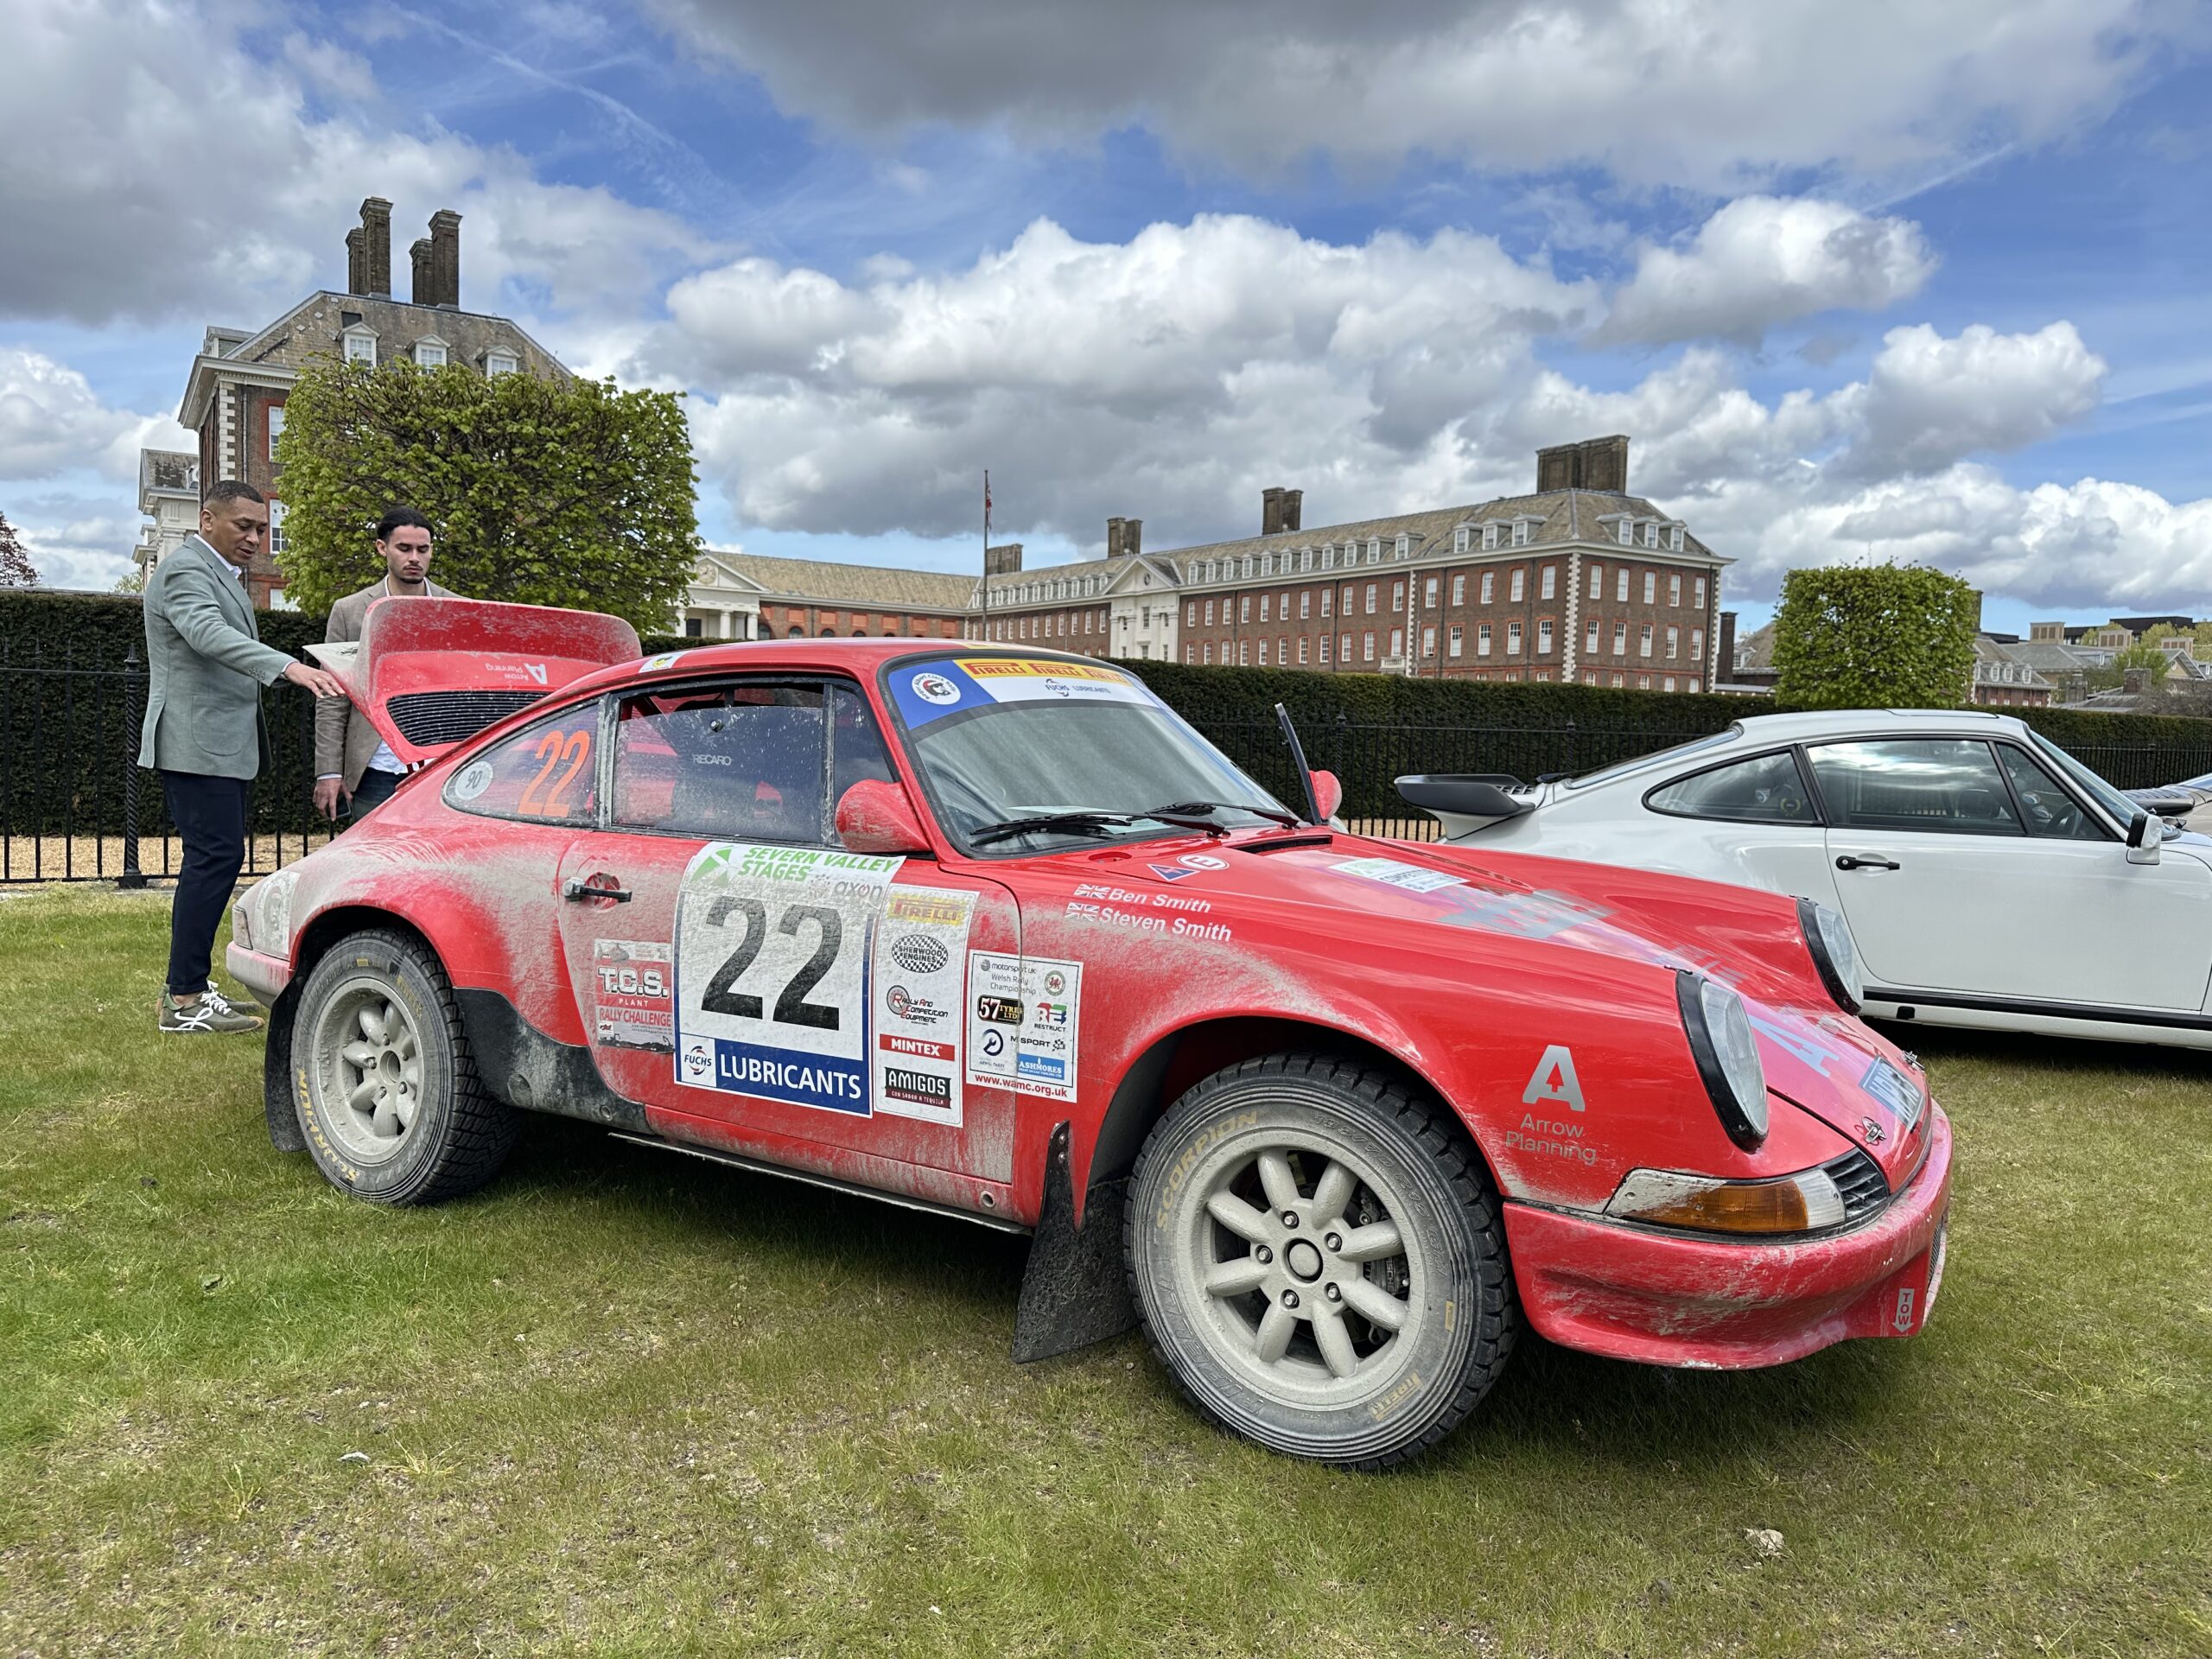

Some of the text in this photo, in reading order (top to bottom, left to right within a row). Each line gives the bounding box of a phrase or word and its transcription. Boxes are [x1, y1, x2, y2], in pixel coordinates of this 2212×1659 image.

[963, 663, 1027, 675] PIRELLI
[1027, 664, 1082, 677] PIRELLI
[693, 754, 732, 766] RECARO
[465, 770, 483, 789] 90
[518, 730, 590, 817] 22
[744, 847, 899, 873] SEVERN VALLEY
[738, 861, 814, 882] STAGES
[834, 880, 883, 901] axon
[1109, 888, 1211, 913] Ben Smith
[893, 898, 963, 921] PIRELLI
[1099, 907, 1232, 942] Steven Smith
[898, 946, 943, 957] SHERWOOD
[903, 952, 937, 963] ENGINES
[701, 895, 842, 1032] 22
[991, 973, 1011, 982] Welsh
[990, 982, 1036, 995] Champioship
[619, 998, 649, 1007] PLANT
[979, 997, 1023, 1020] 57 TYRES
[600, 1007, 622, 1023] RALLY
[624, 1010, 671, 1027] CHALLENGE
[1004, 1011, 1018, 1020] LTD
[1034, 1023, 1067, 1033] RESTRUCT
[891, 1038, 941, 1057] MINTEX
[683, 1053, 862, 1099] FUCHS LUBRICANTS
[1019, 1061, 1062, 1074] ASHMORES
[888, 1071, 946, 1096] AMIGOS
[975, 1074, 1068, 1096] www.wamc.org.uk
[924, 1096, 944, 1105] TEQUILA
[1520, 1113, 1584, 1138] Arrow
[1505, 1130, 1598, 1166] Planning
[1156, 1109, 1258, 1232] SCORPION
[1897, 1293, 1911, 1325] TOW
[1157, 1278, 1266, 1414] PIRELLI
